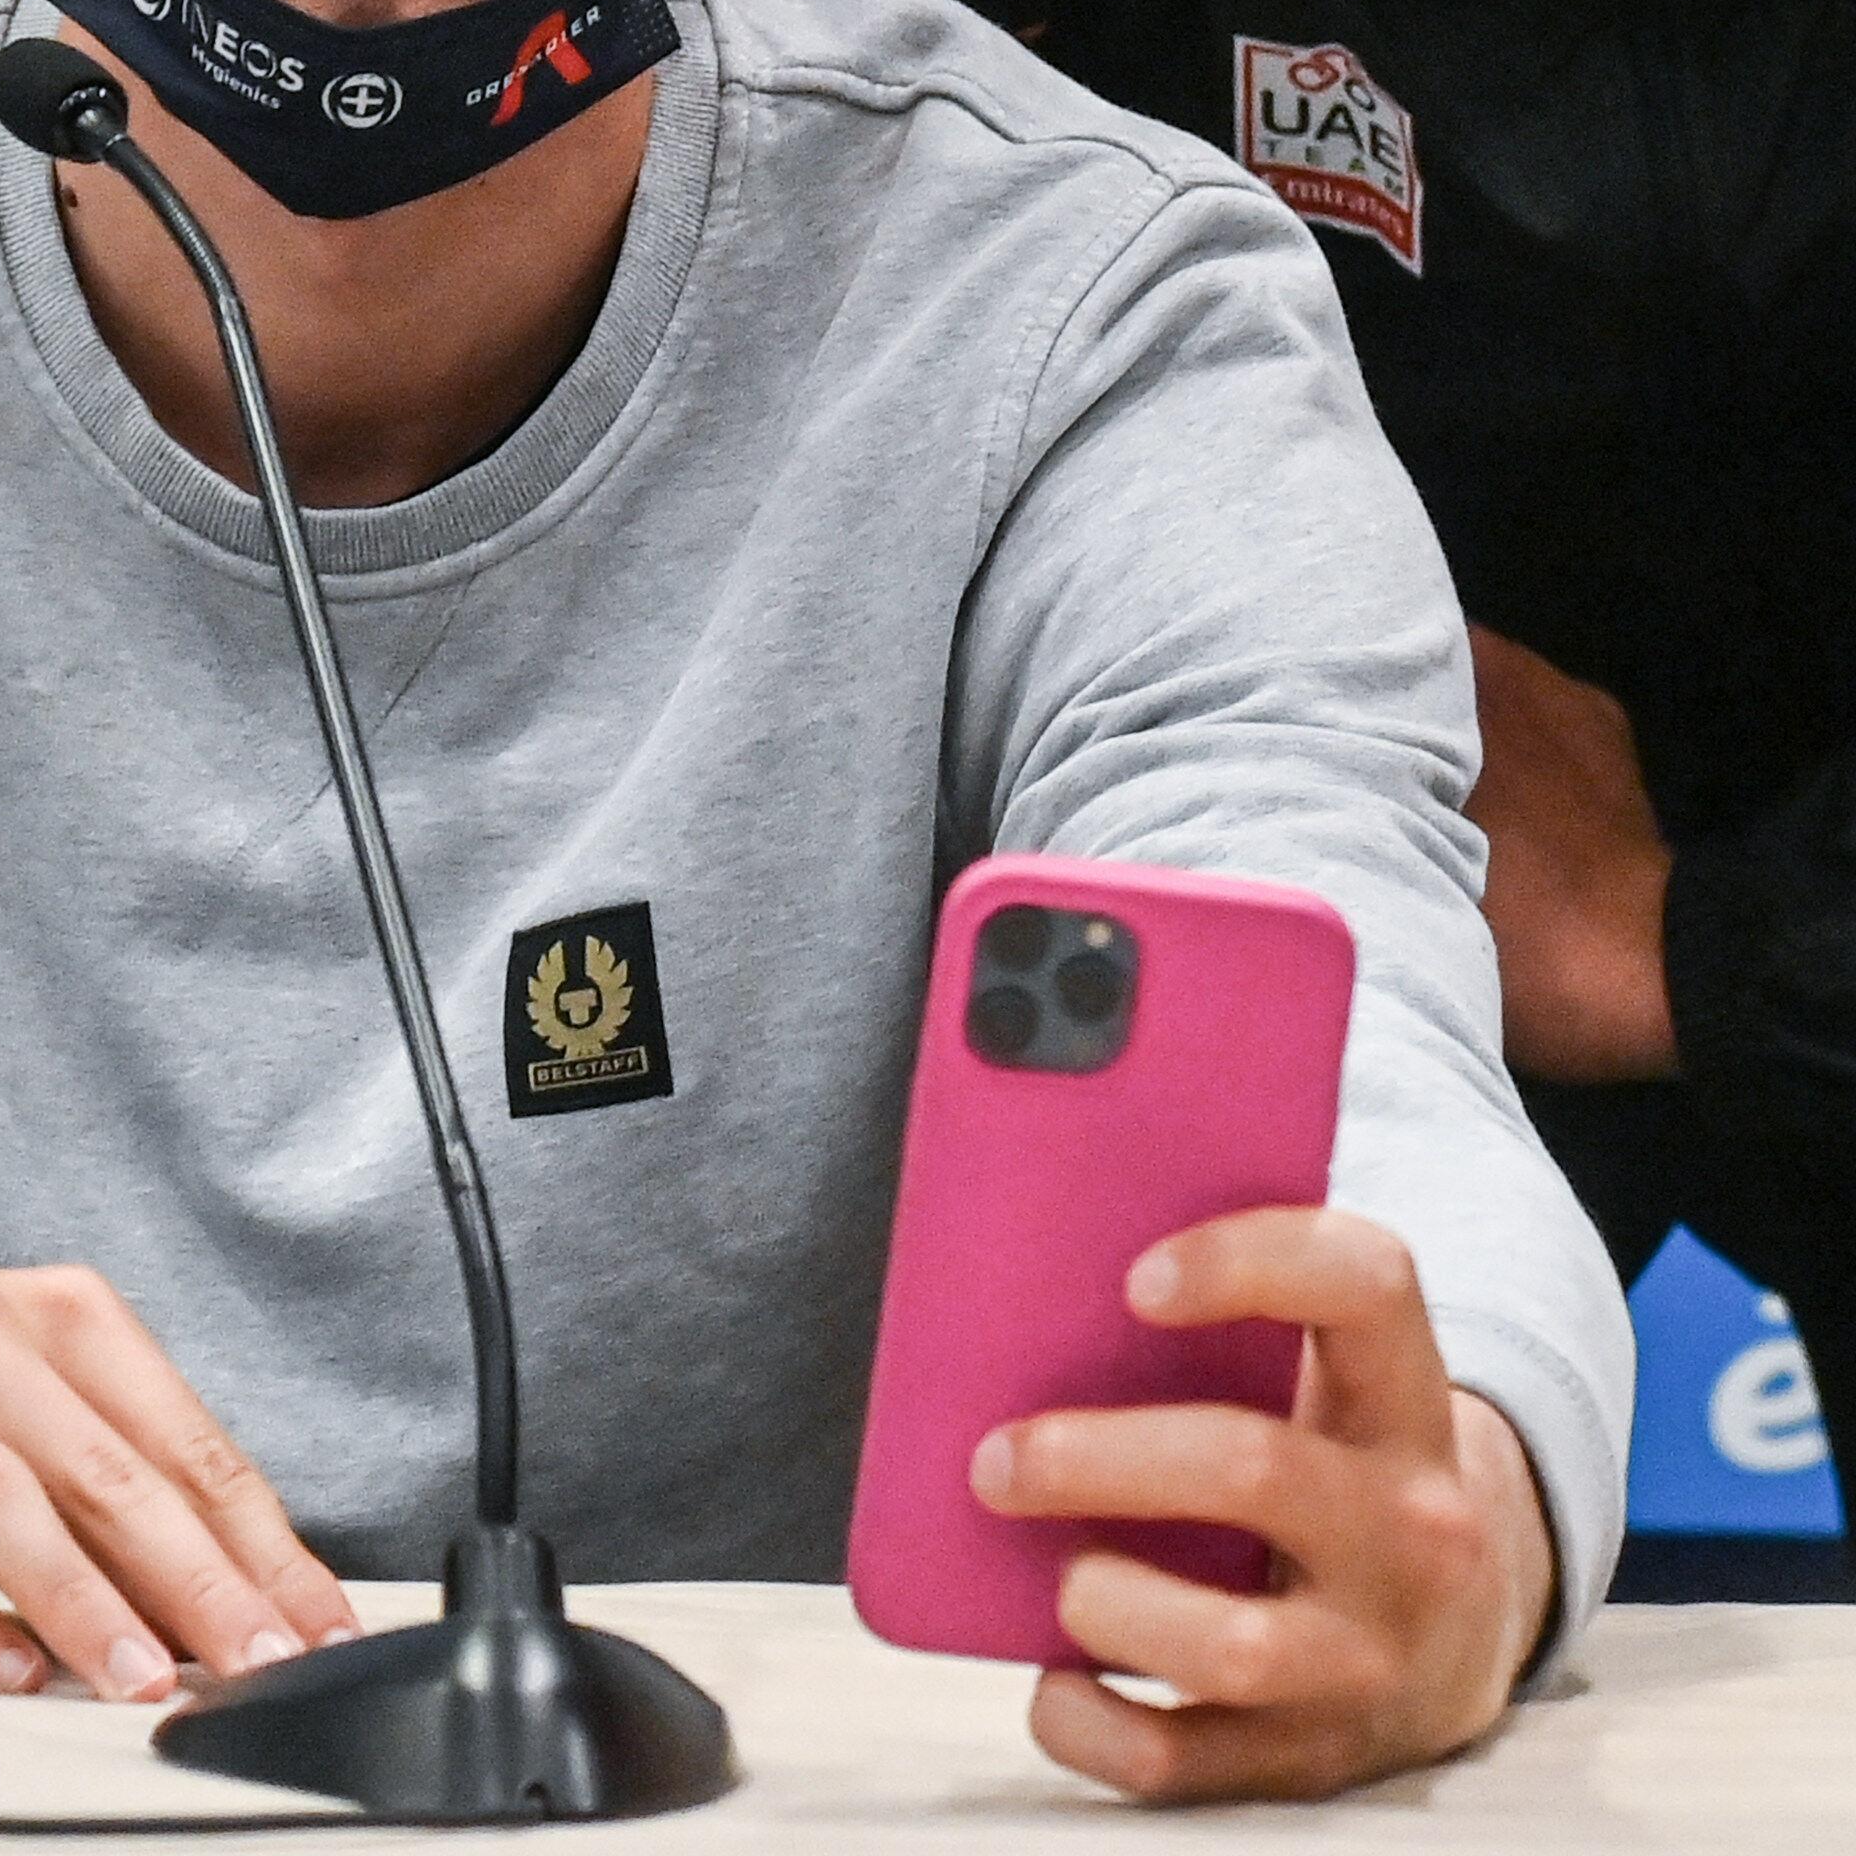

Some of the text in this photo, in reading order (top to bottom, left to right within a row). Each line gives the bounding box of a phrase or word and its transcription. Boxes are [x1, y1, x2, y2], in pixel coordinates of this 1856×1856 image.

[191, 44, 282, 110] Hygienics
[1260, 87, 1402, 177] UAE
[536, 1053, 641, 1083] BELSTAFF
